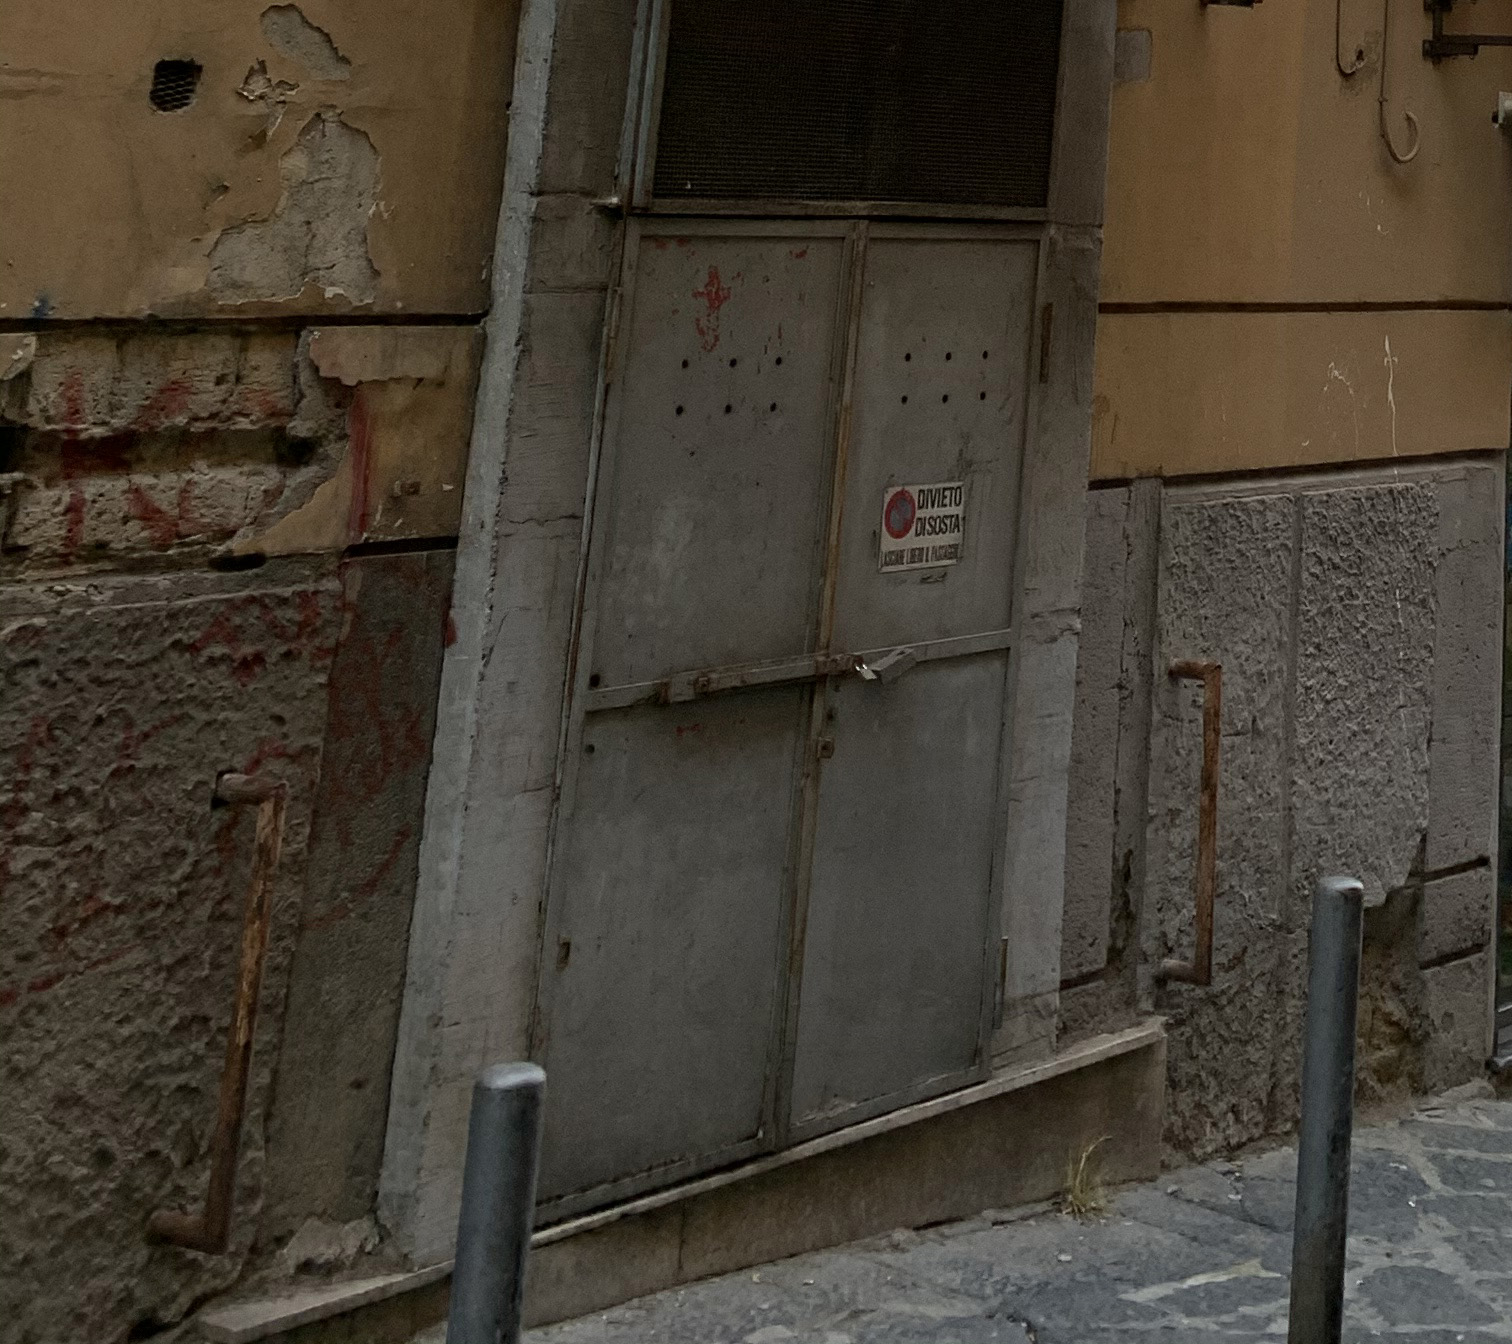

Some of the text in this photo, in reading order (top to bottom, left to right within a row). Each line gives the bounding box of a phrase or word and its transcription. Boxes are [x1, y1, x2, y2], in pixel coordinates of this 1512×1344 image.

[917, 486, 962, 510] DIVIETO
[914, 515, 960, 537] DI SOSTA
